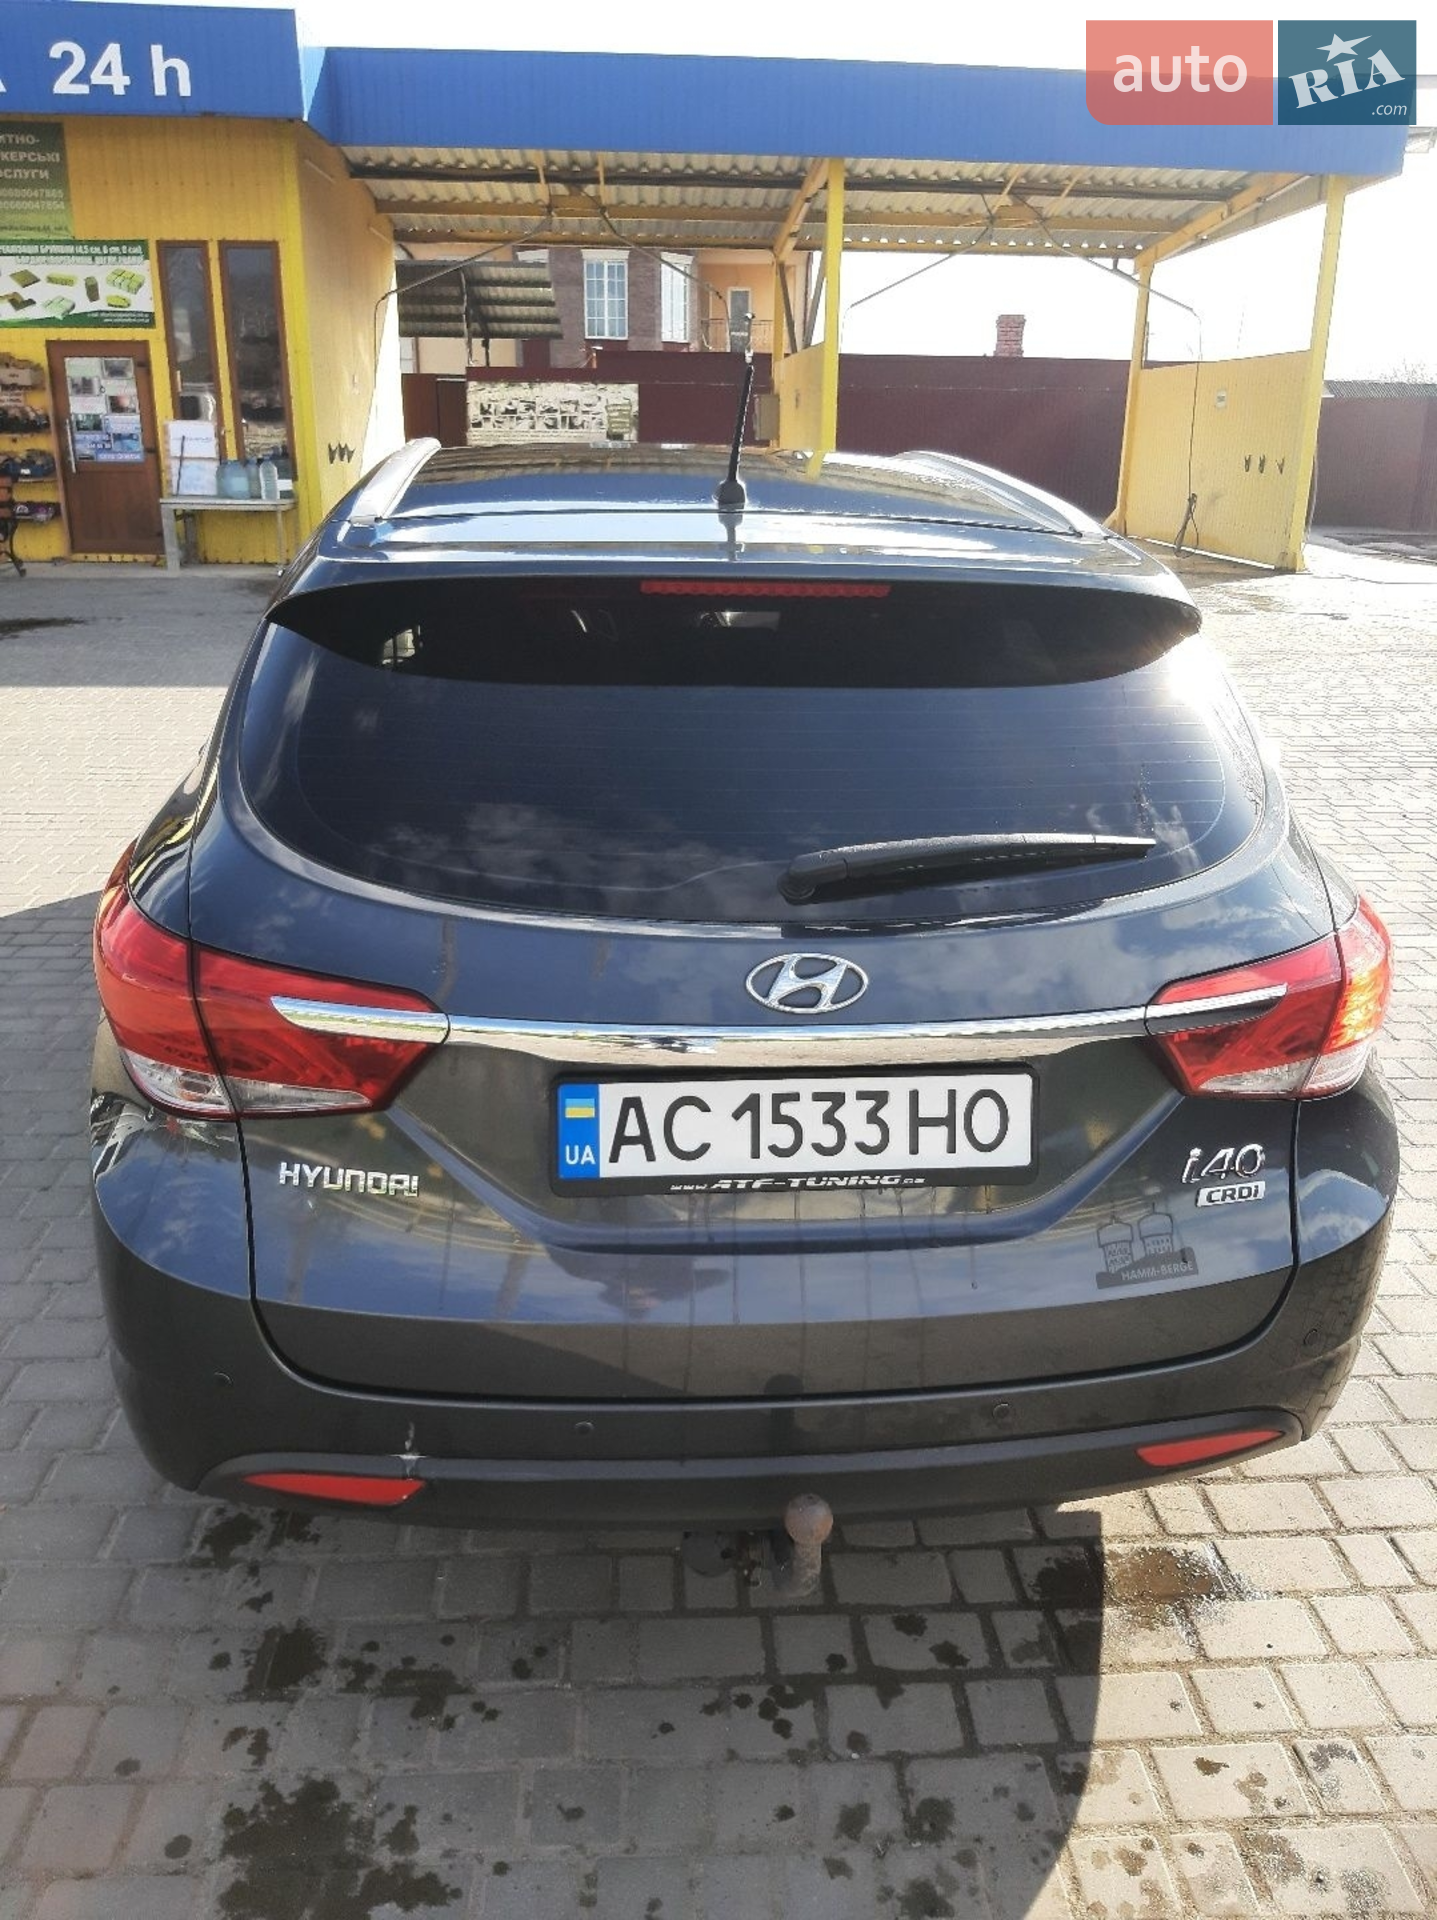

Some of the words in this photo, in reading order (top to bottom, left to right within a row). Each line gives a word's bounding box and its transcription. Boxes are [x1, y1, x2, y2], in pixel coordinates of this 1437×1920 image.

[50, 41, 131, 95] 24
[151, 44, 191, 96] h
[608, 1096, 712, 1163] AC
[731, 1090, 890, 1159] 1533
[908, 1088, 1010, 1155] HO
[565, 1145, 596, 1166] UA
[1181, 1143, 1266, 1184] i40
[279, 1161, 419, 1197] HYUNDAI
